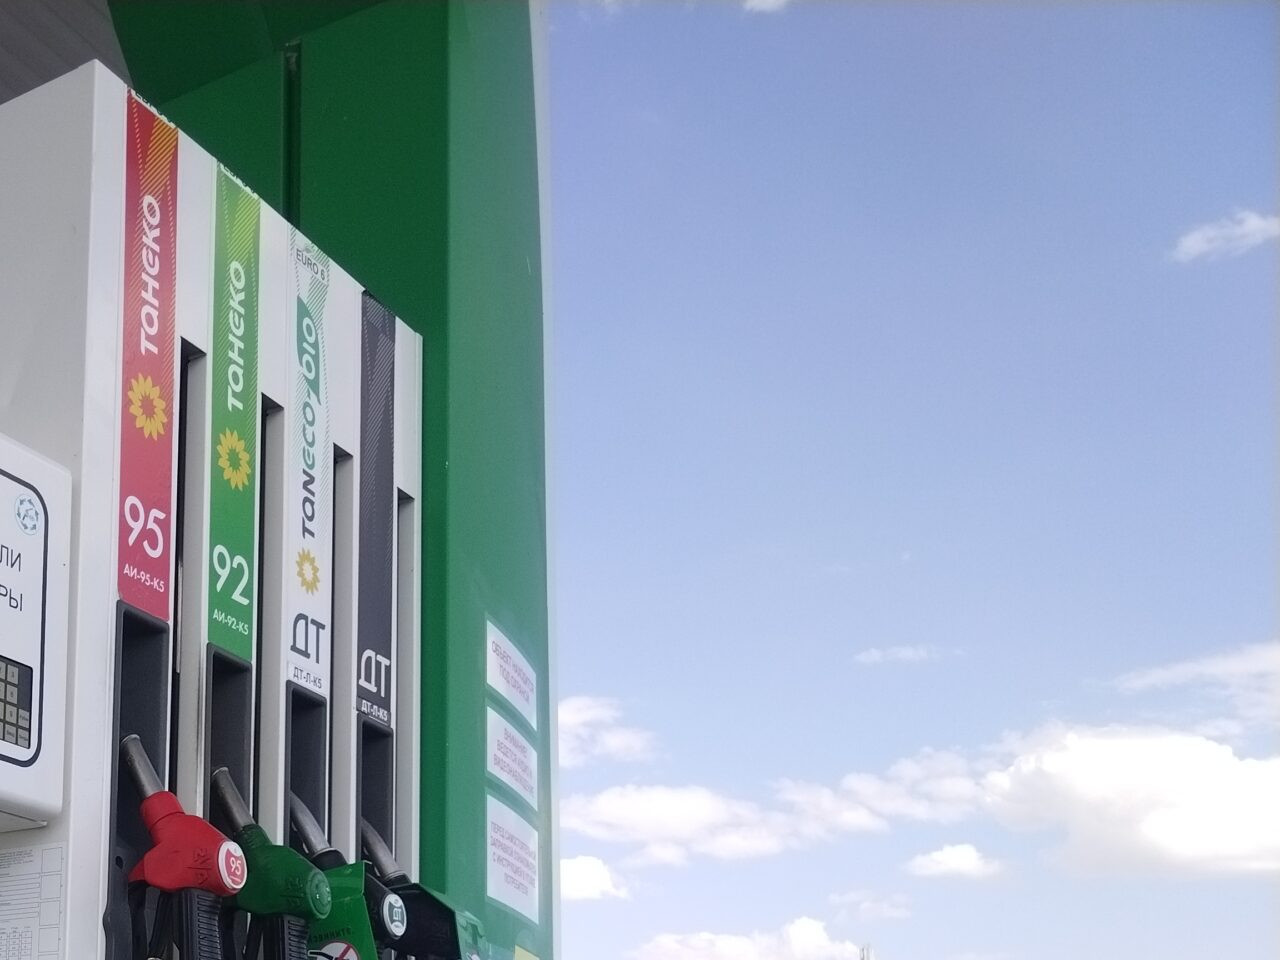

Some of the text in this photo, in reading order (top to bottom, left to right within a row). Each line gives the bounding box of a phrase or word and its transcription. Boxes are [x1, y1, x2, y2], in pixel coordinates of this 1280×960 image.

[296, 249, 326, 281] EURO 6
[123, 495, 167, 558] 95
[123, 563, 166, 593] АИ-95-К5
[213, 544, 250, 606] 92
[213, 608, 250, 636] АИ-92-К5
[290, 612, 326, 665] ДТ
[358, 648, 391, 698] ДТ
[229, 857, 242, 876] 95
